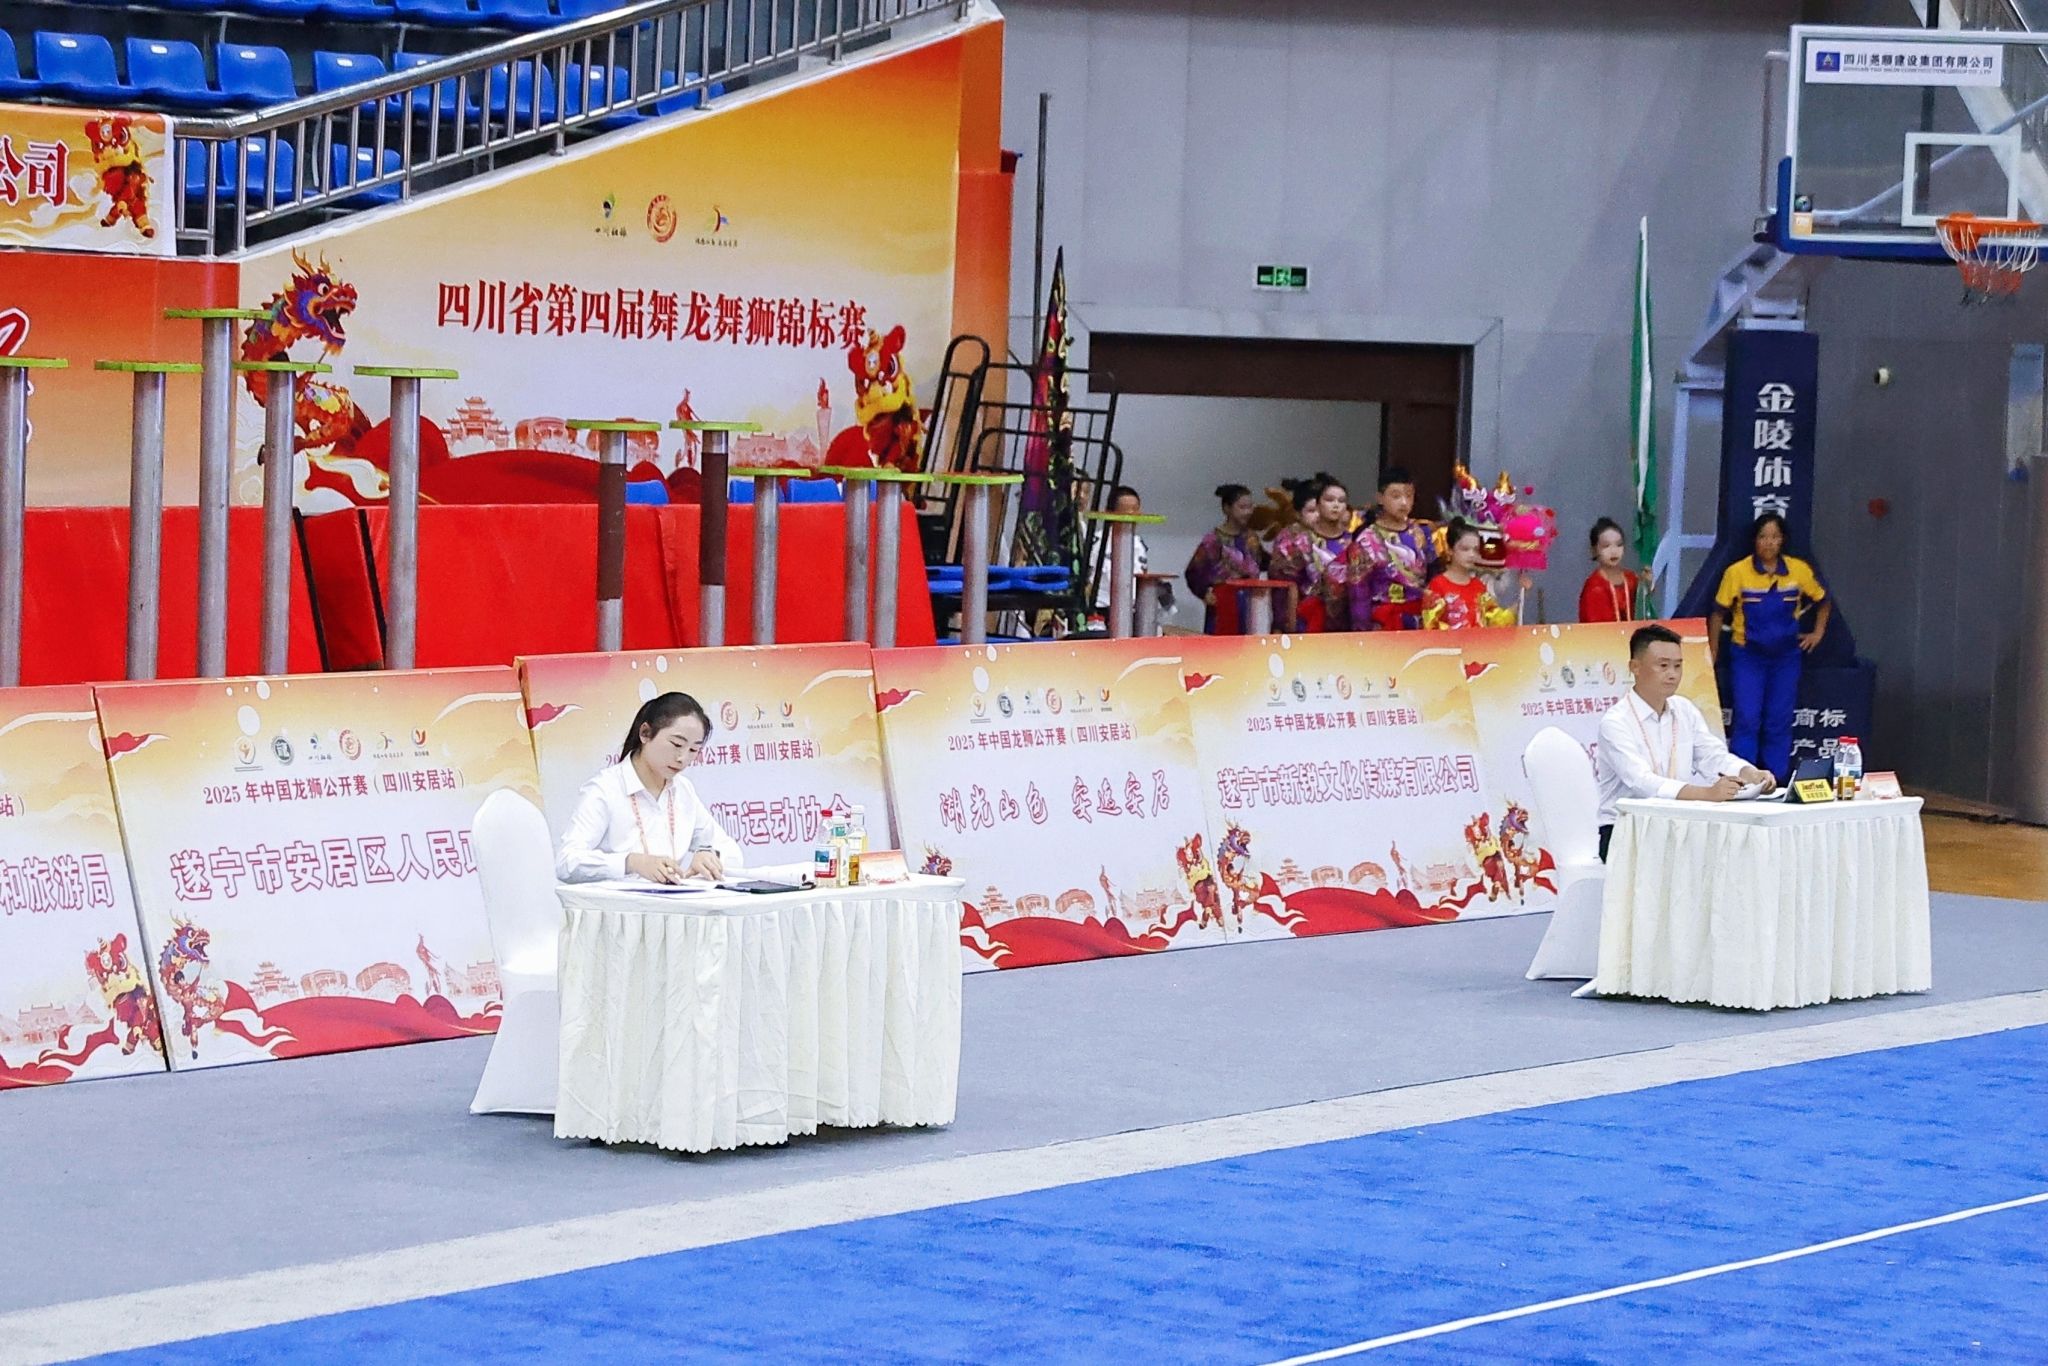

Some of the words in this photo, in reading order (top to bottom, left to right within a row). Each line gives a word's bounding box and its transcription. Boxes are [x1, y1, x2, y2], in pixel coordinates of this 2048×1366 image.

[437, 279, 867, 350] 四川省第四届舞龙舞狮锦标赛
[1217, 755, 1480, 809] 遂宁市新锐文化传媒有限公司
